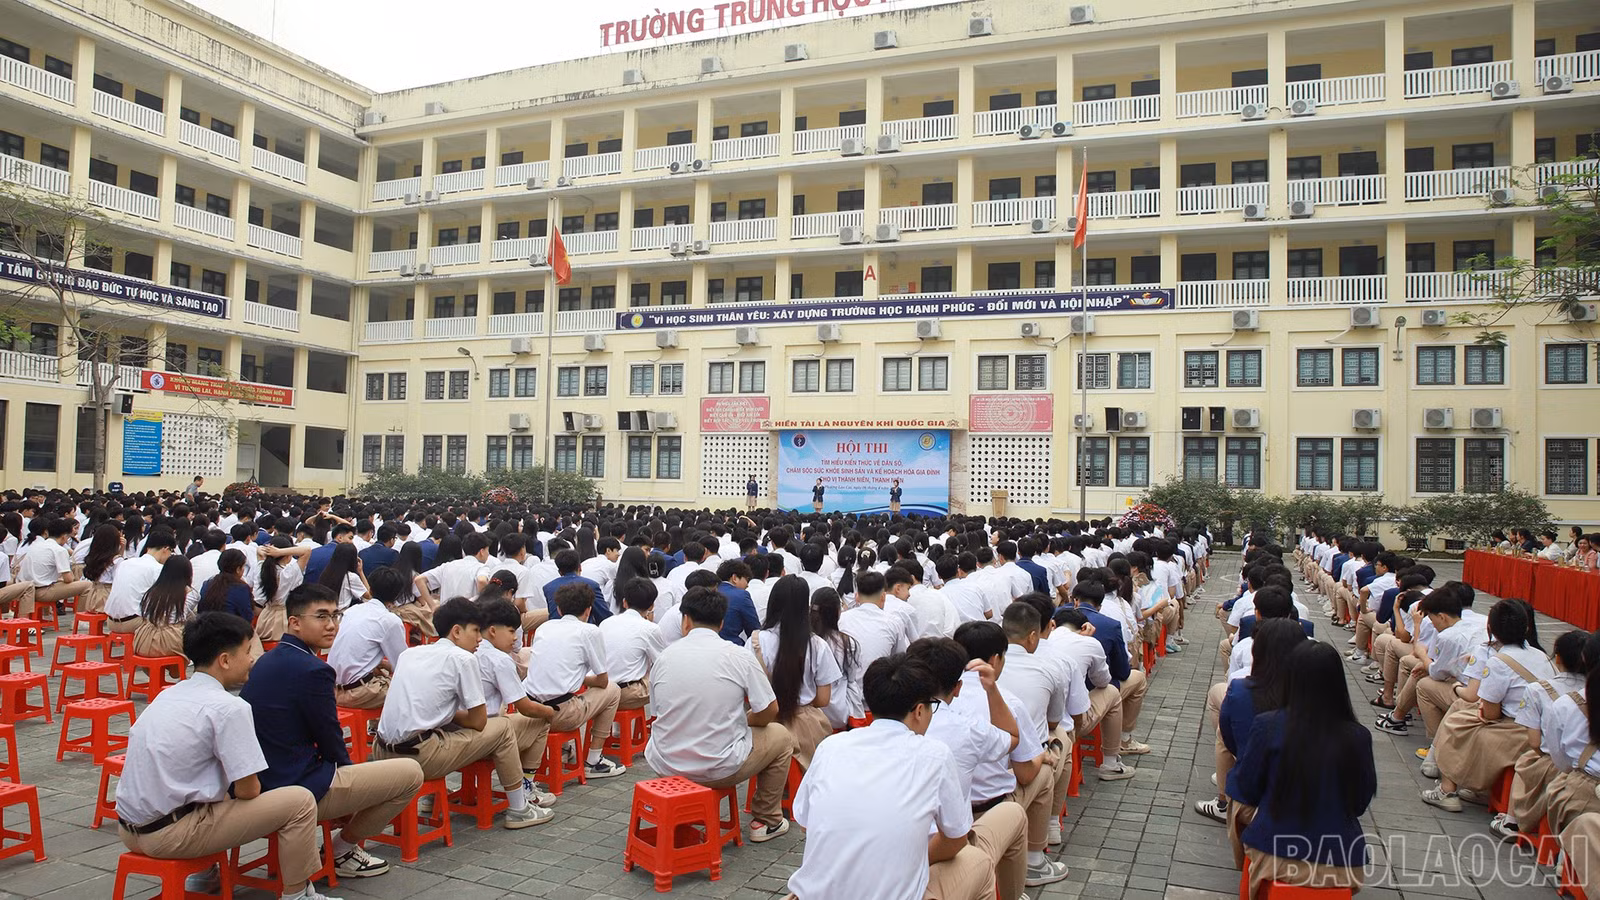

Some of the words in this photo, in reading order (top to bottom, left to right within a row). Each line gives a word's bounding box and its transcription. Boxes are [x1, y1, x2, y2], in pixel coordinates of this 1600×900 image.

[600, 8, 704, 46] TRƯỜNG
[714, 0, 805, 28] TRUNG
[812, 0, 871, 16] HỌ
[864, 265, 876, 281] A
[6, 262, 32, 278] TẤM
[78, 277, 99, 292] ĐẠO
[102, 280, 122, 295] ĐỨC
[125, 286, 139, 300] TỰ
[140, 290, 160, 302] HỌC
[162, 293, 173, 304] VÀ
[176, 295, 200, 310] SÁNG
[202, 302, 218, 314] TẠO
[666, 316, 686, 325] HỌC
[689, 314, 713, 323] SINH
[717, 312, 743, 321] THÂN
[746, 310, 770, 320] YÊU:
[773, 309, 794, 319] XÂY
[797, 308, 827, 319] DỰNG
[831, 306, 876, 316] TRƯỜNG
[880, 306, 902, 316] HỌC
[906, 304, 939, 315] HẠNH
[942, 302, 975, 312] PHÚC
[987, 299, 1008, 311] ĐỔI
[1012, 299, 1036, 310] MỚI
[1040, 299, 1057, 309] VÀ
[1060, 298, 1082, 310] HỘI
[836, 440, 860, 455] HỘI
[865, 442, 888, 453] THI
